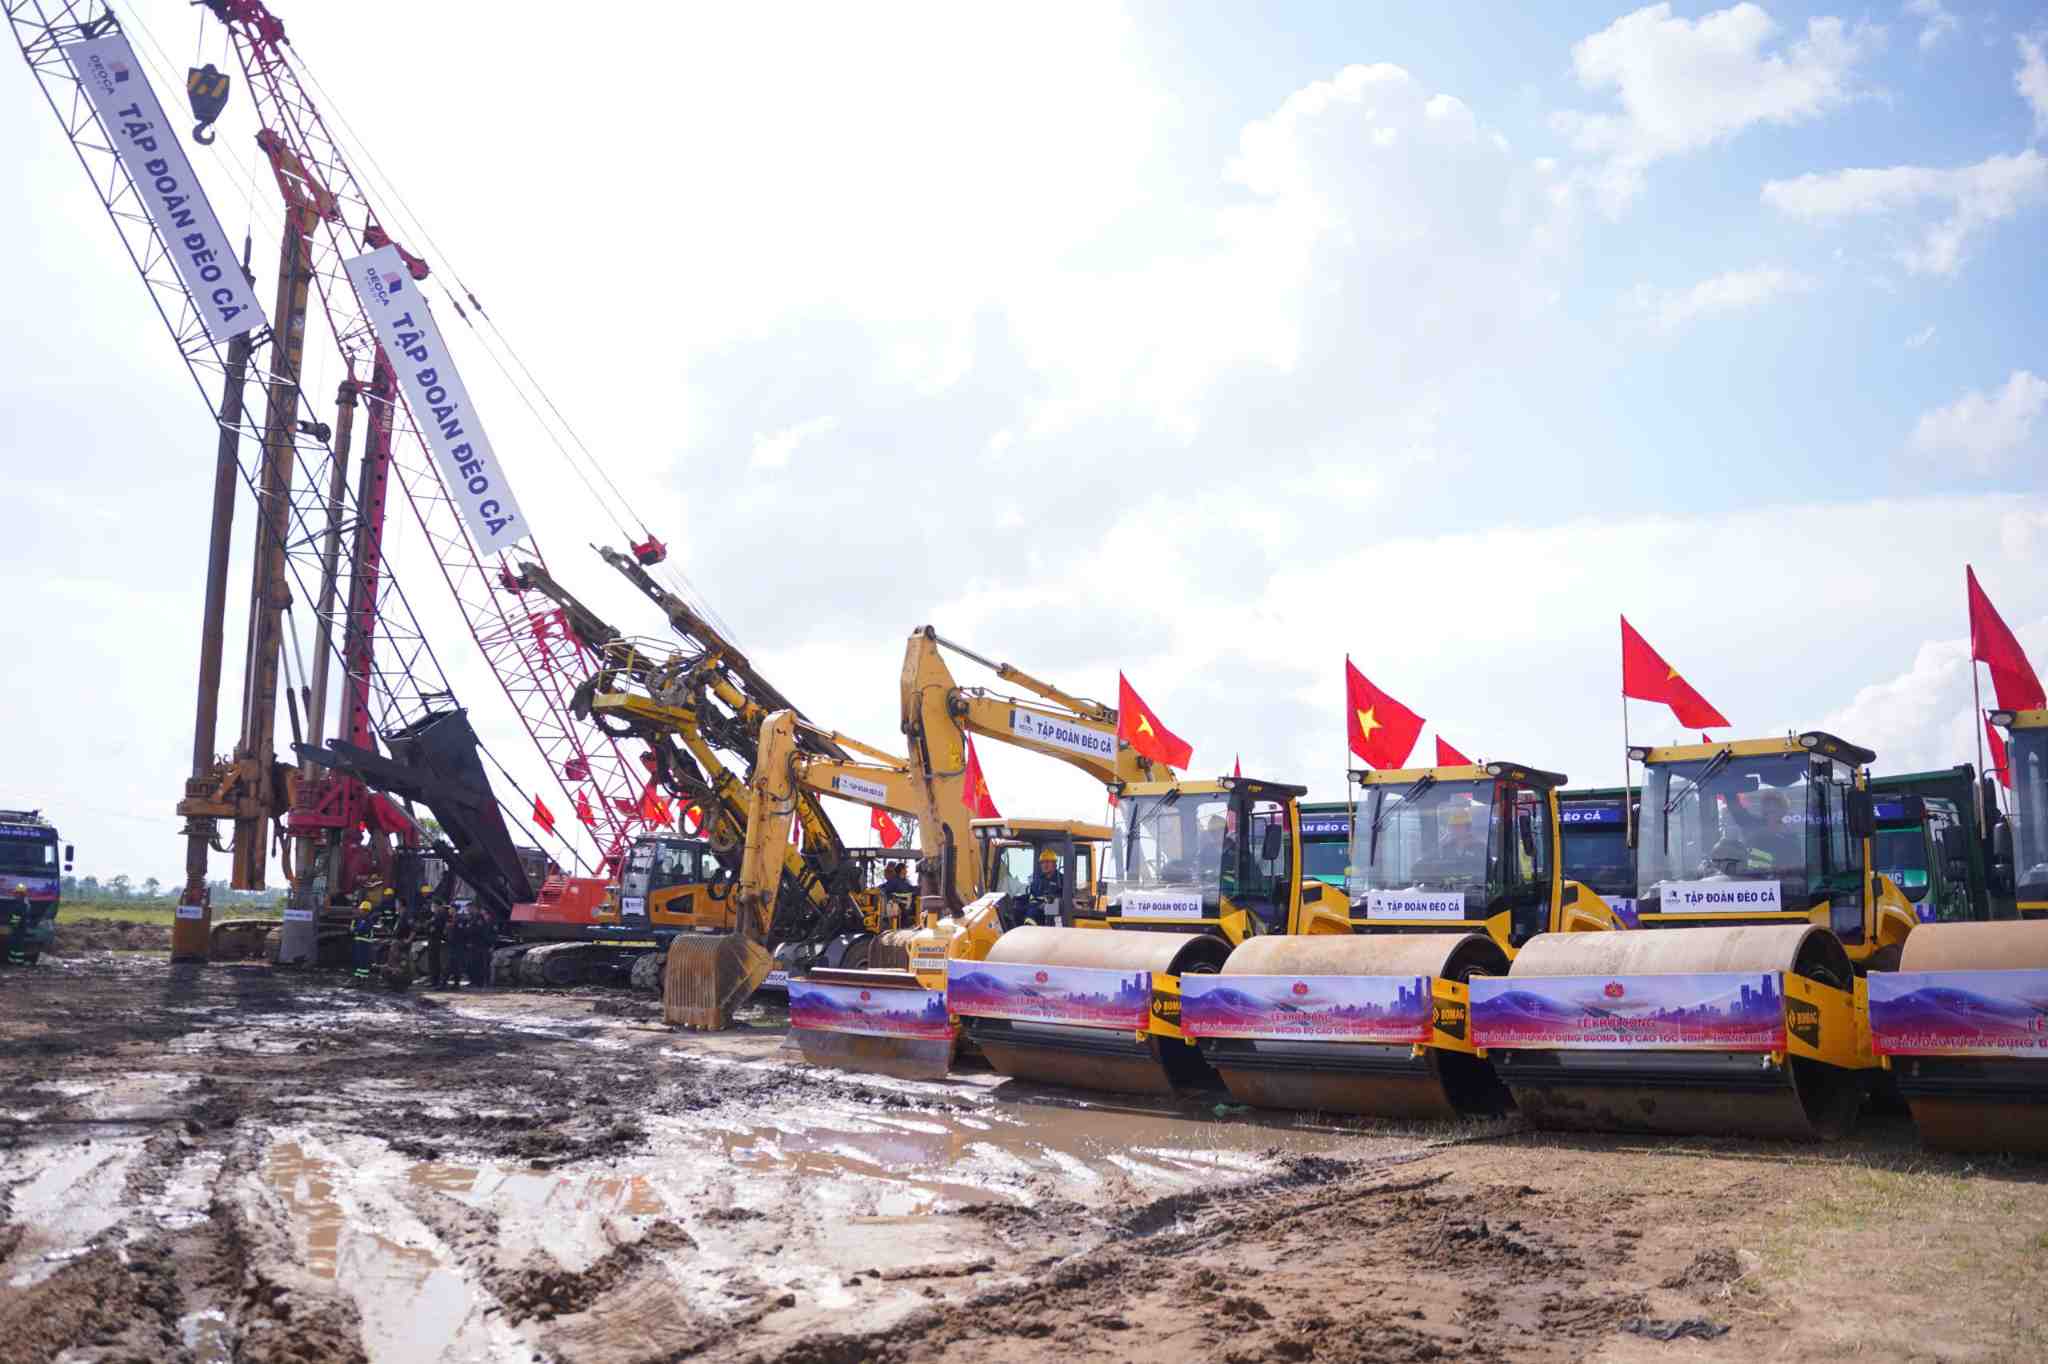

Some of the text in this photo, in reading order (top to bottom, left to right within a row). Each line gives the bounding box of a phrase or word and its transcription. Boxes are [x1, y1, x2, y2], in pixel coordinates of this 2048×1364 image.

[118, 102, 249, 322] TẬP ĐOÀN ĐÈO CẢ
[392, 311, 515, 536] TẬP ĐOÀN ĐÈO CẢ
[1037, 720, 1054, 740] TẬP
[1056, 727, 1080, 745] ĐOÀN
[1100, 736, 1112, 753] CẢ
[1404, 899, 1427, 911] ĐOÀN
[1684, 887, 1775, 907] TẬP ĐOÀN ĐÈO CẢ
[1634, 1033, 1656, 1042] CAO
